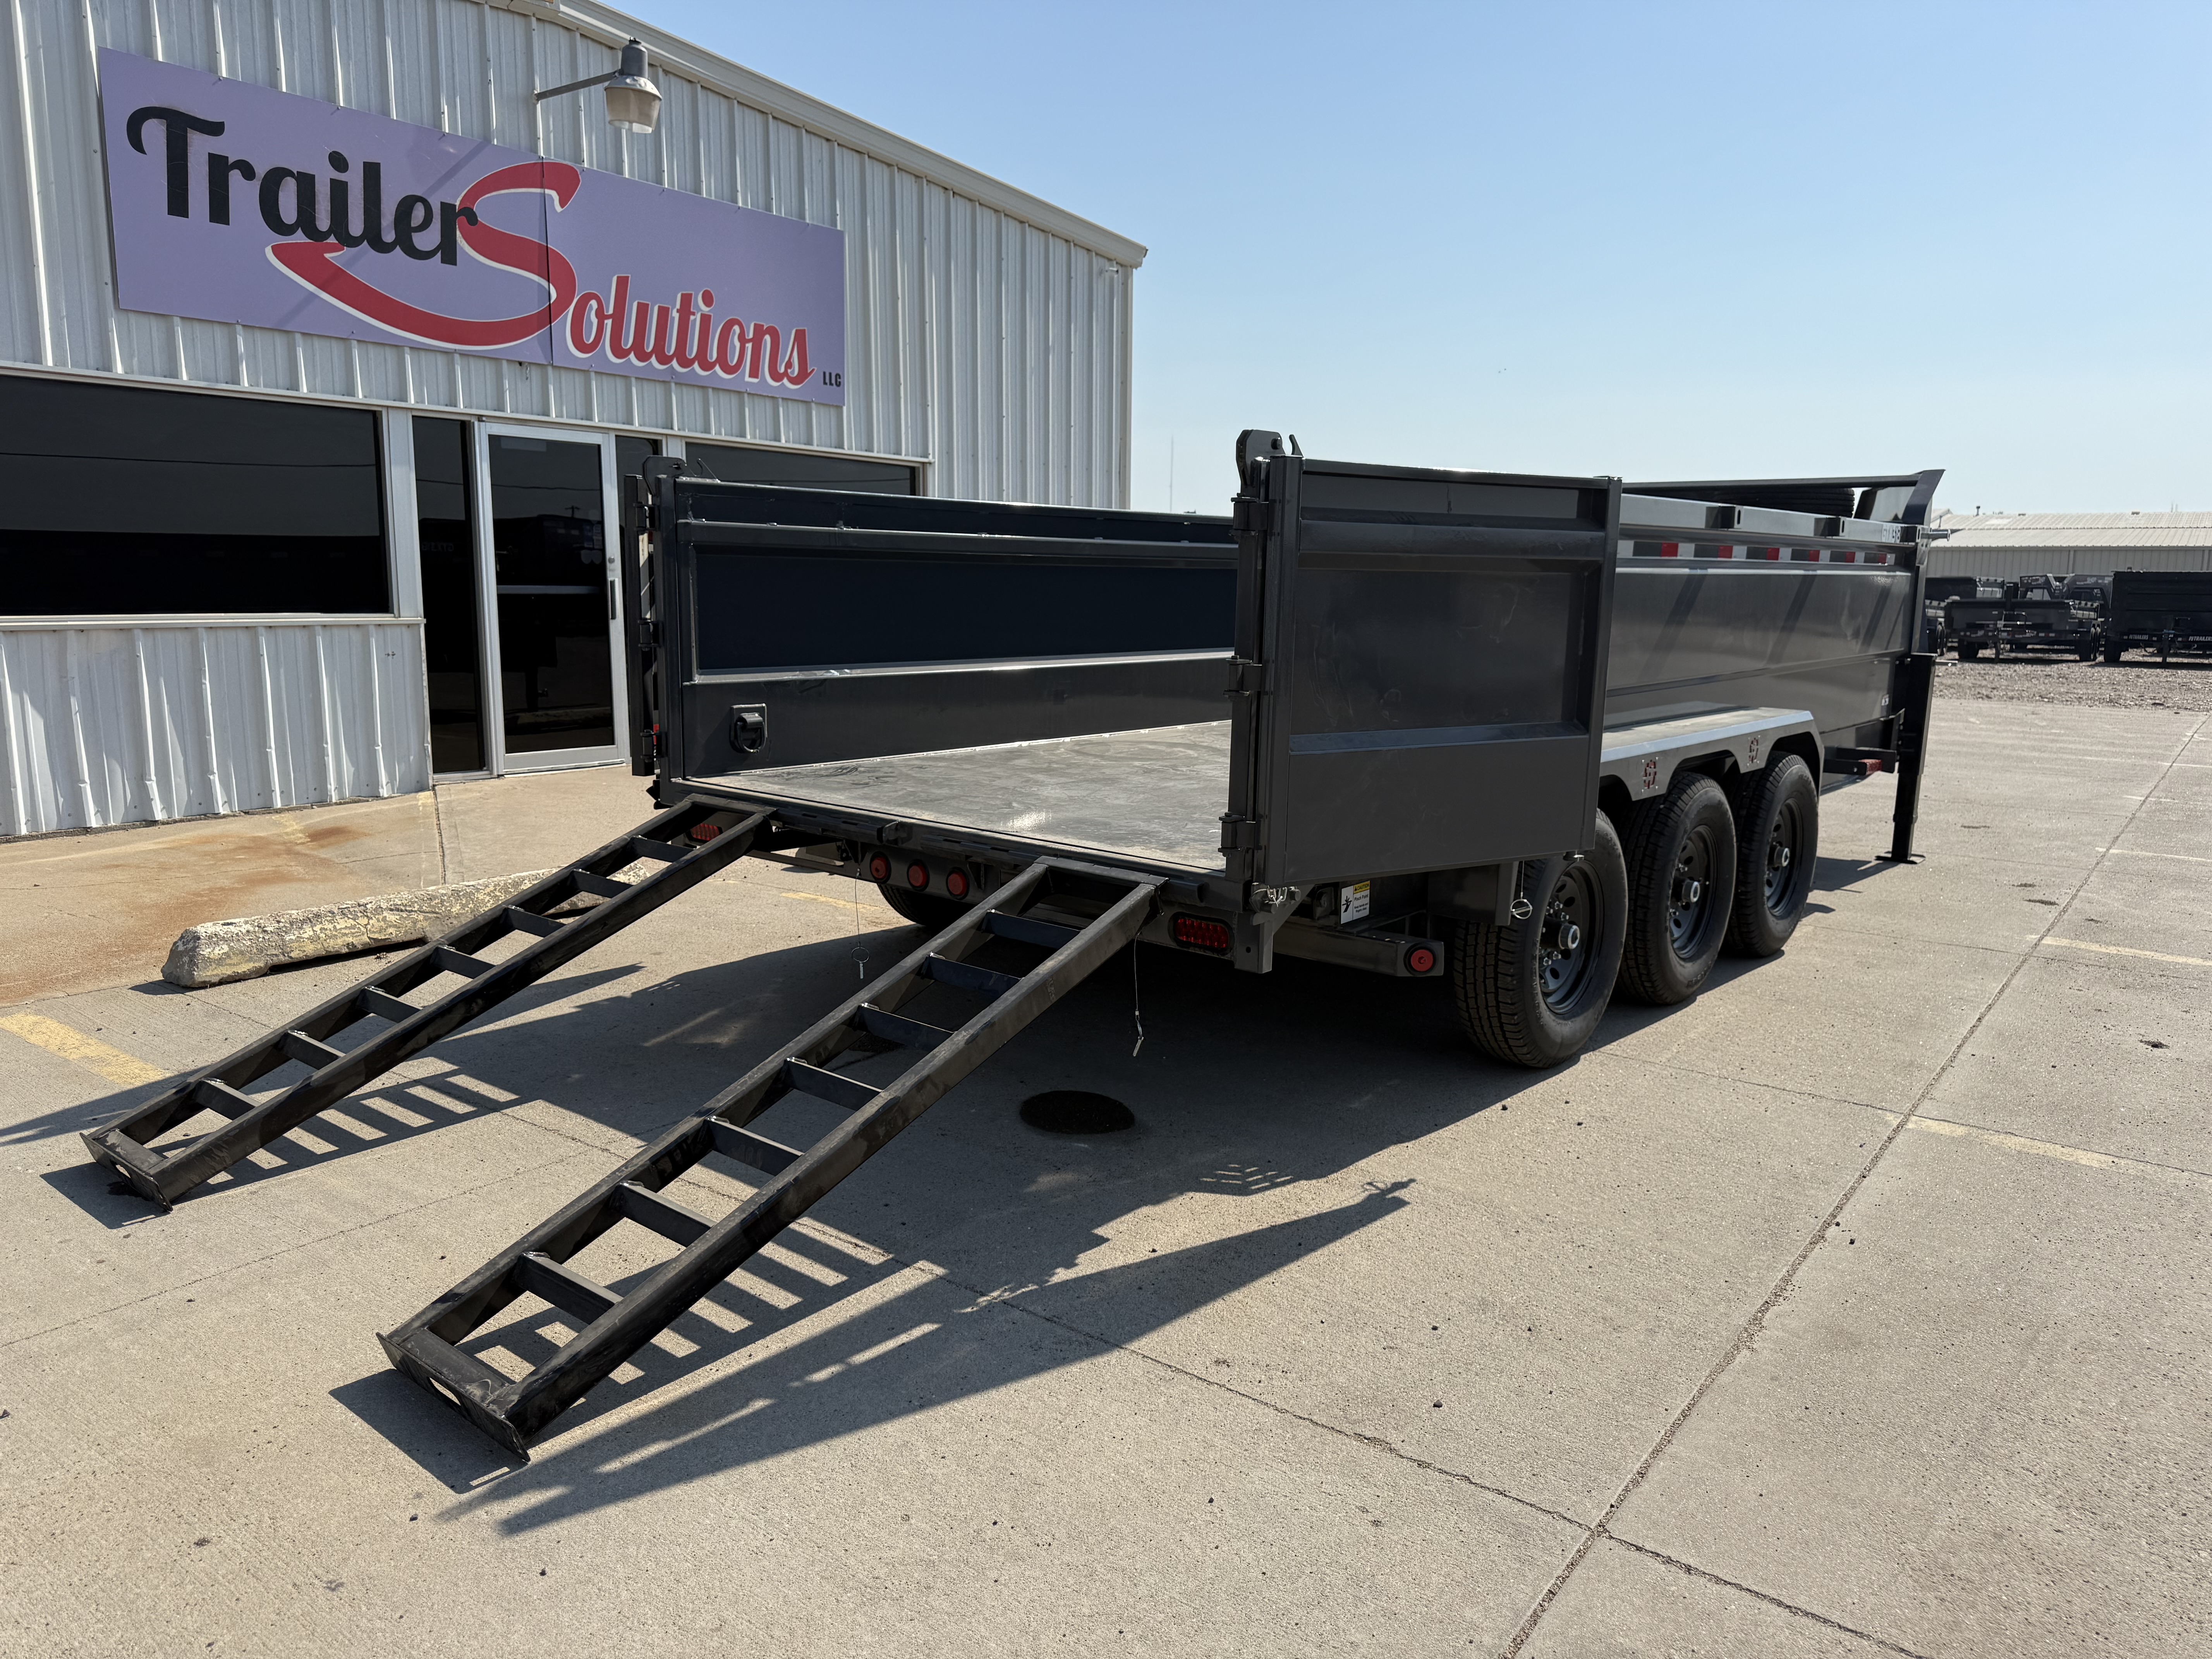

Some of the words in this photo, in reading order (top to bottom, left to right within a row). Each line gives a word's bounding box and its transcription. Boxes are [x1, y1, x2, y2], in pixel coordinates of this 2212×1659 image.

[127, 106, 478, 266] Trailer
[266, 161, 816, 387] Solutions
[823, 371, 841, 387] LLC
